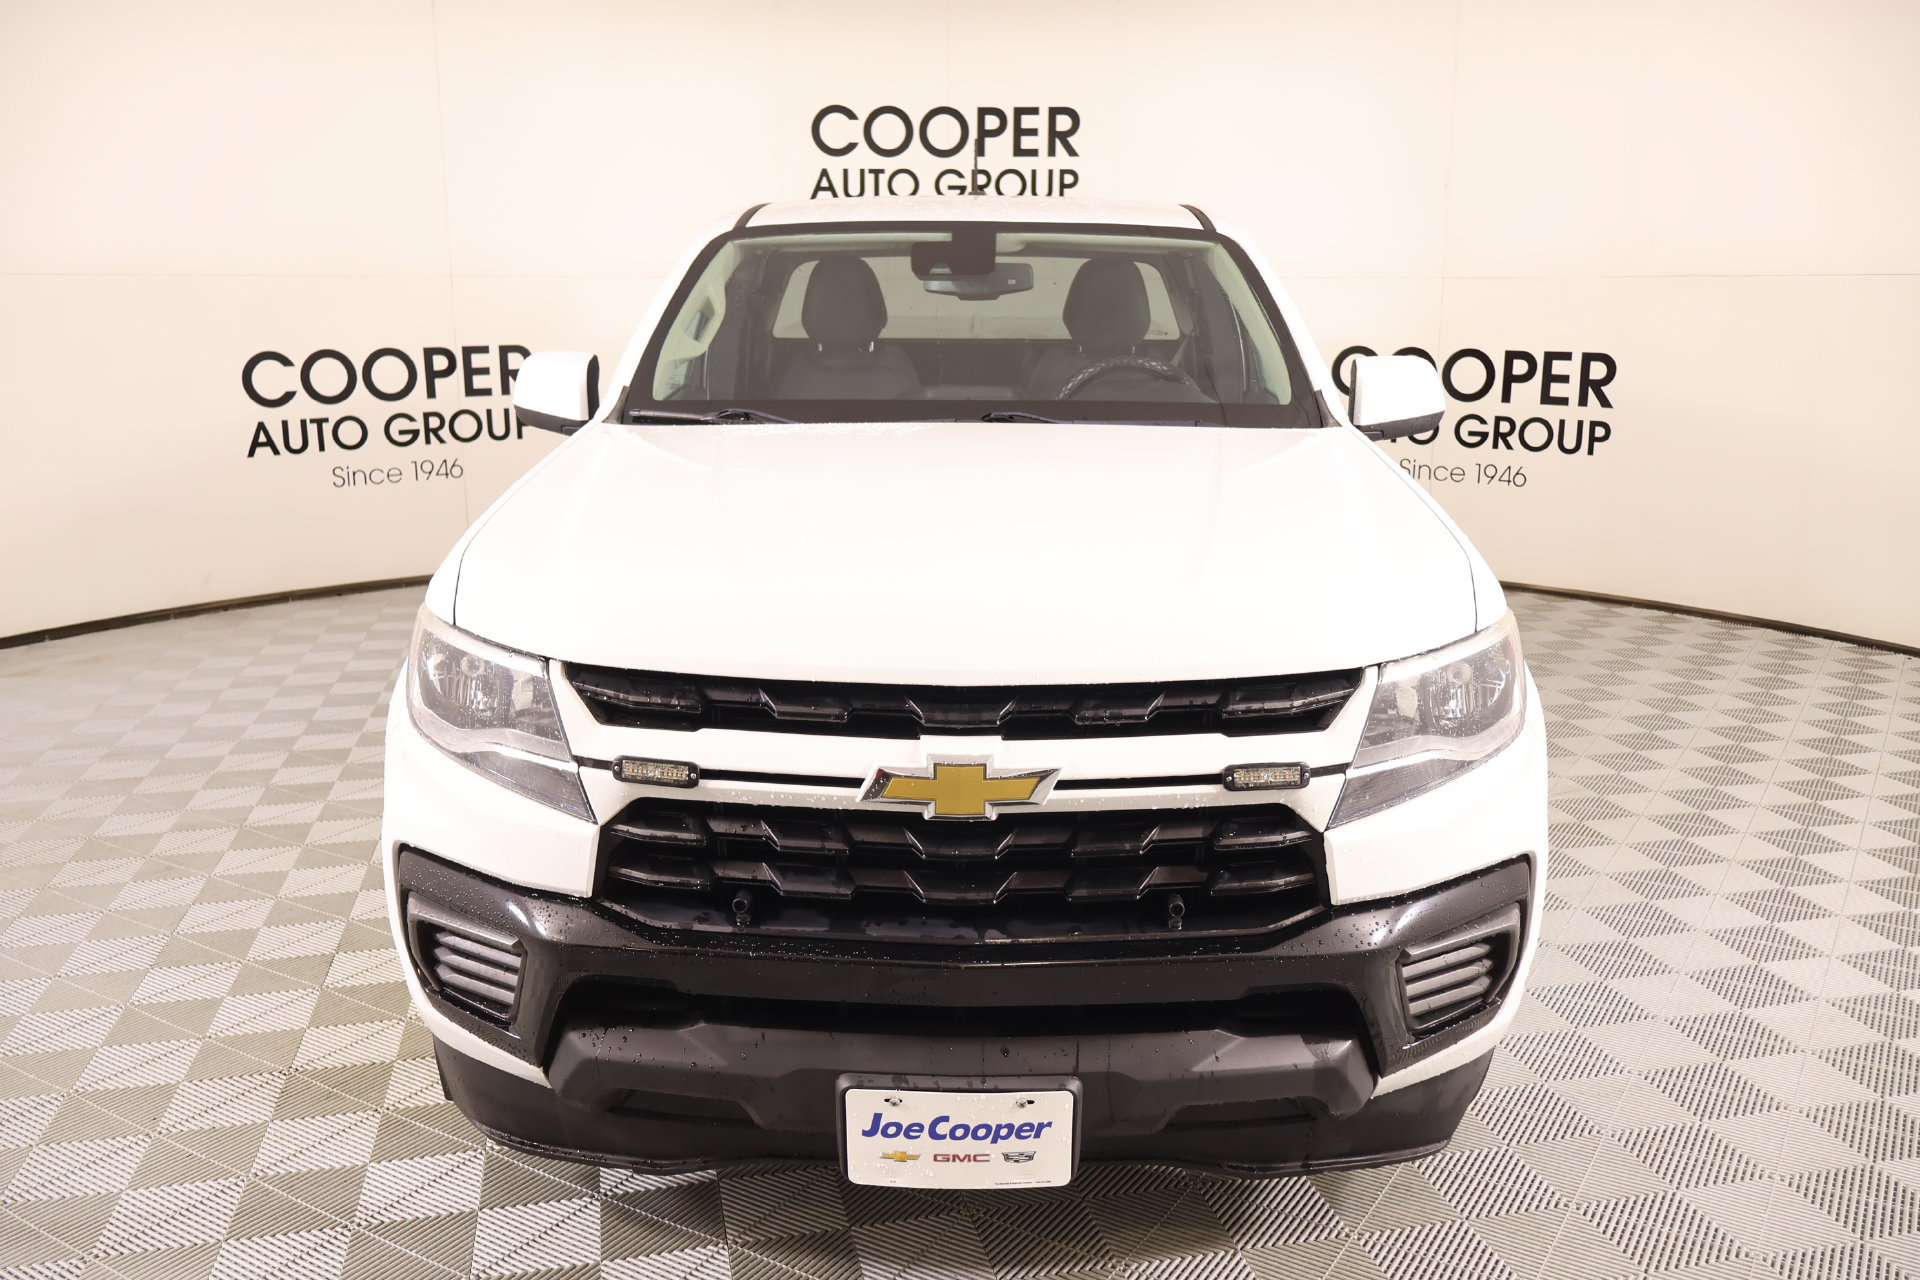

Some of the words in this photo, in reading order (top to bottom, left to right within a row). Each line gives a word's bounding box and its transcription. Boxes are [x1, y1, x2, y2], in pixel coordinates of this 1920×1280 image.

[811, 104, 1081, 158] COOPER
[810, 168, 919, 200] AUTO
[934, 168, 1079, 197] GROUP
[241, 345, 532, 408] COOPER
[1331, 345, 1617, 408] COPER
[247, 415, 368, 458] AUTO
[1454, 414, 1611, 456] GROUP
[332, 465, 402, 488] Since
[411, 458, 463, 482] 1946
[1399, 458, 1465, 482] Since
[1475, 463, 1527, 487] 1946
[933, 1153, 991, 1163] GMC
